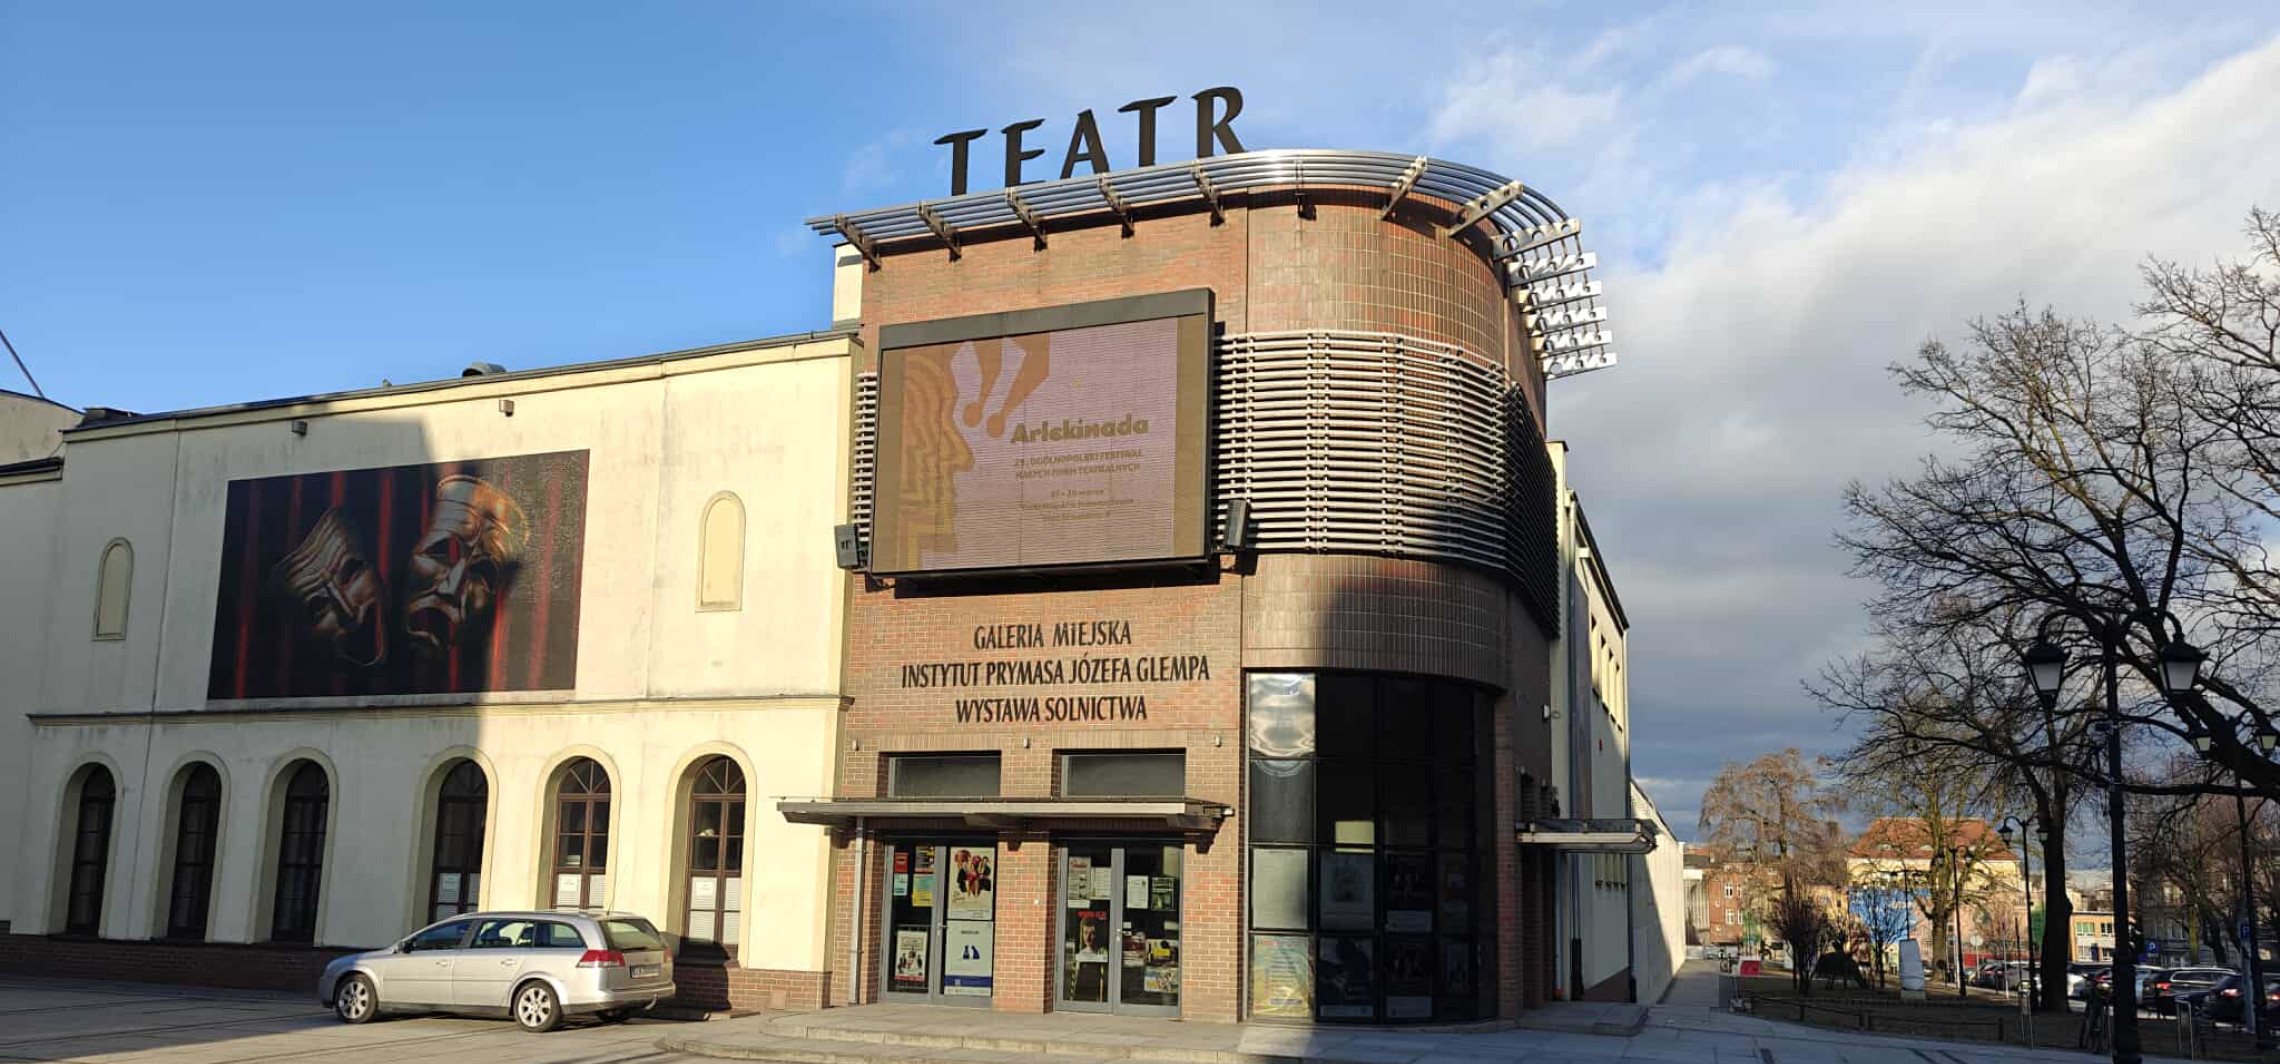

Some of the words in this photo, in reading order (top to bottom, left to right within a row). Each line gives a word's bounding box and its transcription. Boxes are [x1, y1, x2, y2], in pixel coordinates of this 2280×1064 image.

[933, 86, 1247, 196] TEATR
[974, 623, 1044, 649] GALERIA
[902, 662, 982, 688] INSTYTUT
[986, 658, 1064, 687] PRYMASA
[1069, 651, 1132, 684] JÓZEFA
[1136, 655, 1211, 682] GLEMPA
[956, 697, 1041, 723] WYSTAWA
[1044, 695, 1148, 722] SOLNICTWA
